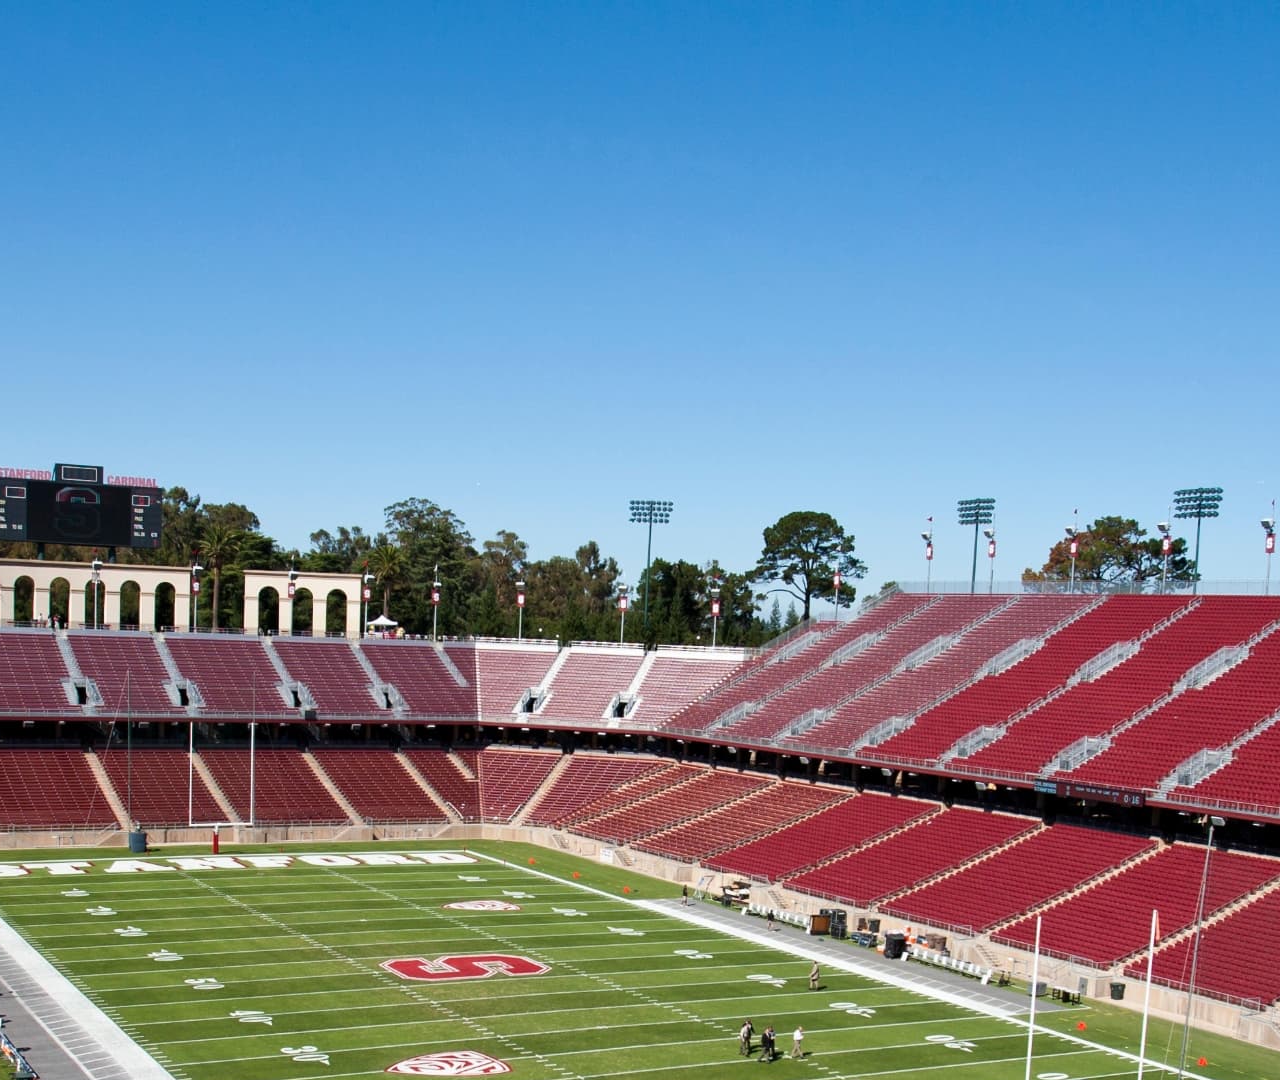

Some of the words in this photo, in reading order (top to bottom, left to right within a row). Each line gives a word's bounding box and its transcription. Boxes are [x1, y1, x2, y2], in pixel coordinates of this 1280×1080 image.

[107, 475, 158, 488] CARDINAL
[379, 953, 553, 981] S
[184, 978, 224, 990] 50
[230, 1010, 273, 1023] 40
[280, 1045, 330, 1062] 30
